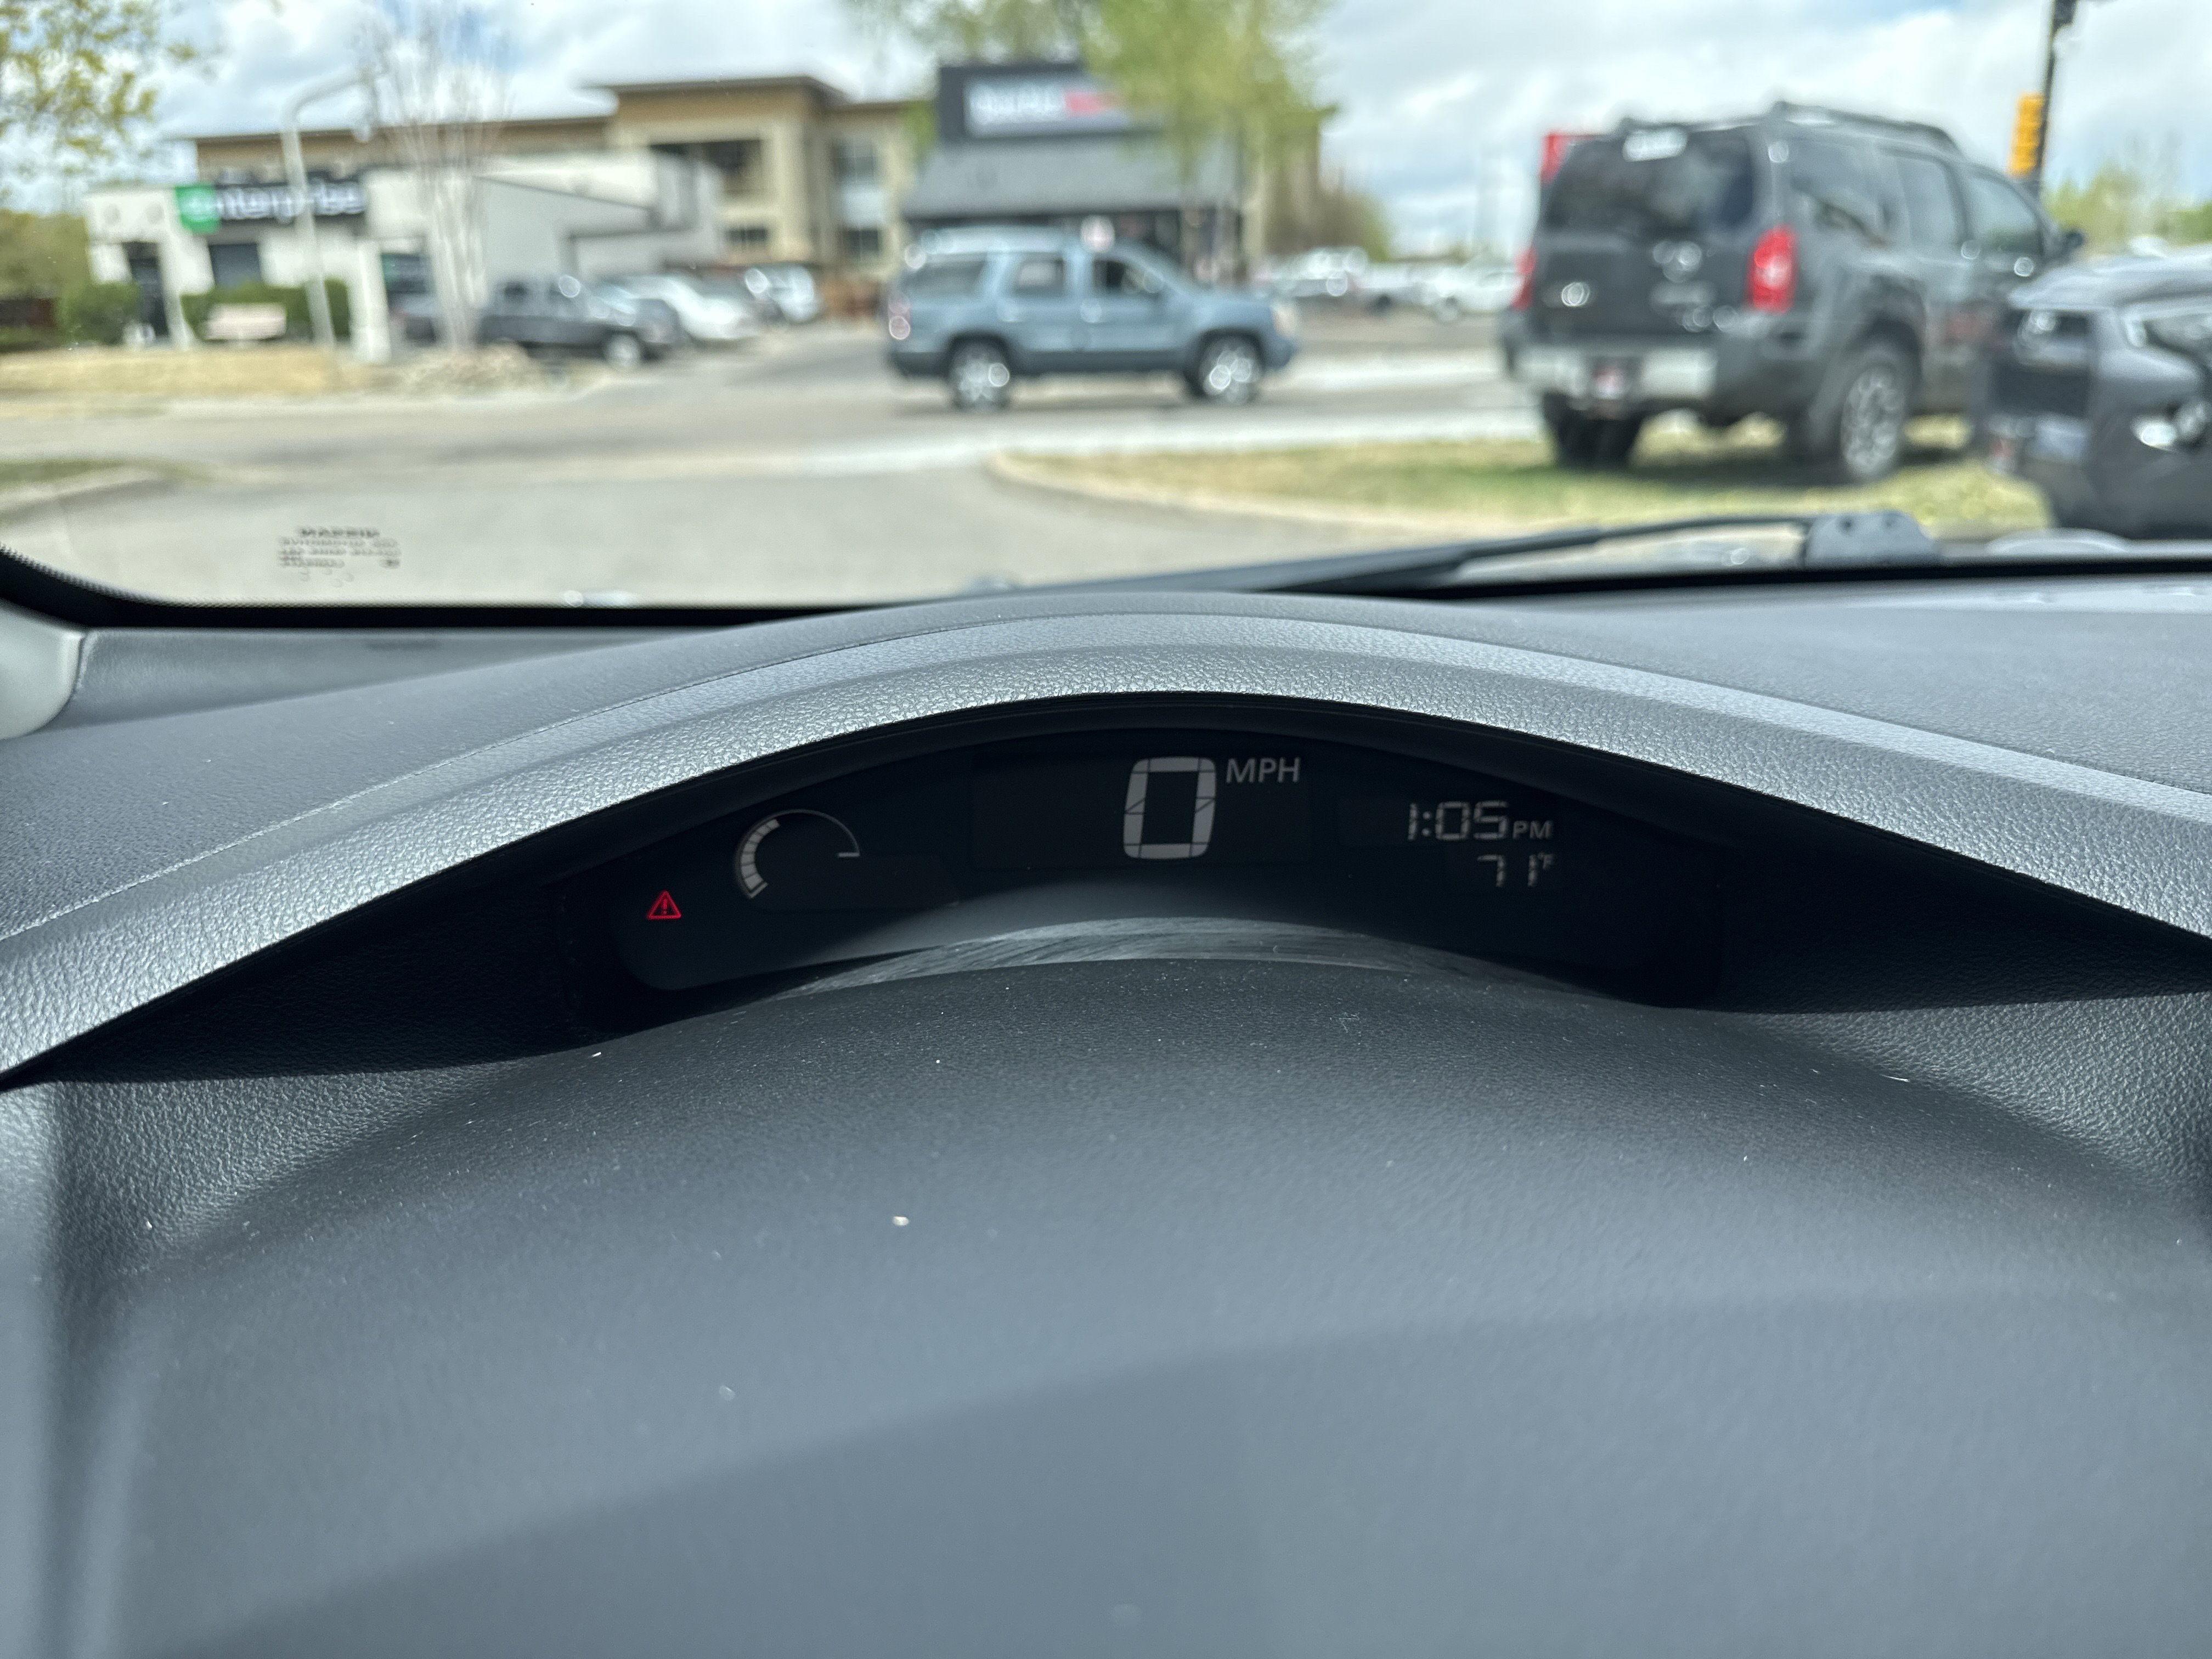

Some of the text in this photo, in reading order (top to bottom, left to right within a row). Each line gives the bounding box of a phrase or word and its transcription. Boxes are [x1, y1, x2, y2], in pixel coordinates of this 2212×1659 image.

[1124, 757, 1300, 859] 0 MPH
[1407, 800, 1553, 840] 1:05 PM
